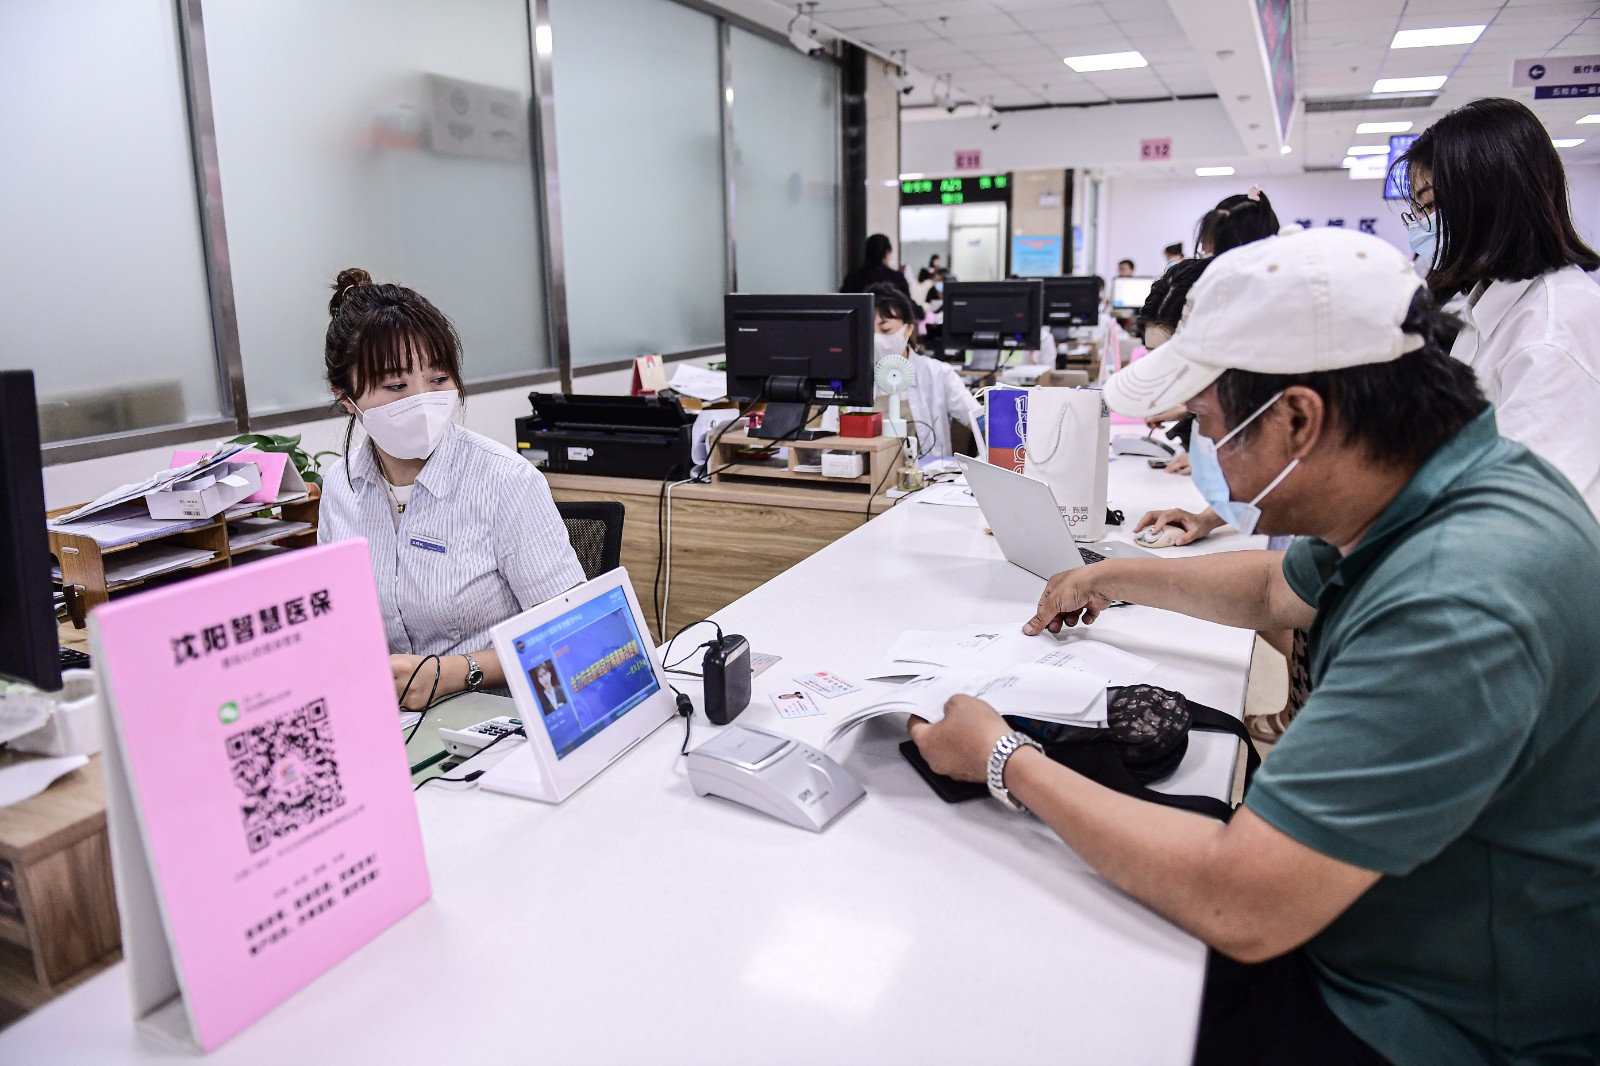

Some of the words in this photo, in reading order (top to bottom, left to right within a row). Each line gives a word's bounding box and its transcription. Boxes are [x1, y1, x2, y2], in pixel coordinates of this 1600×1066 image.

[170, 588, 333, 666] 沈阳智慧医保
